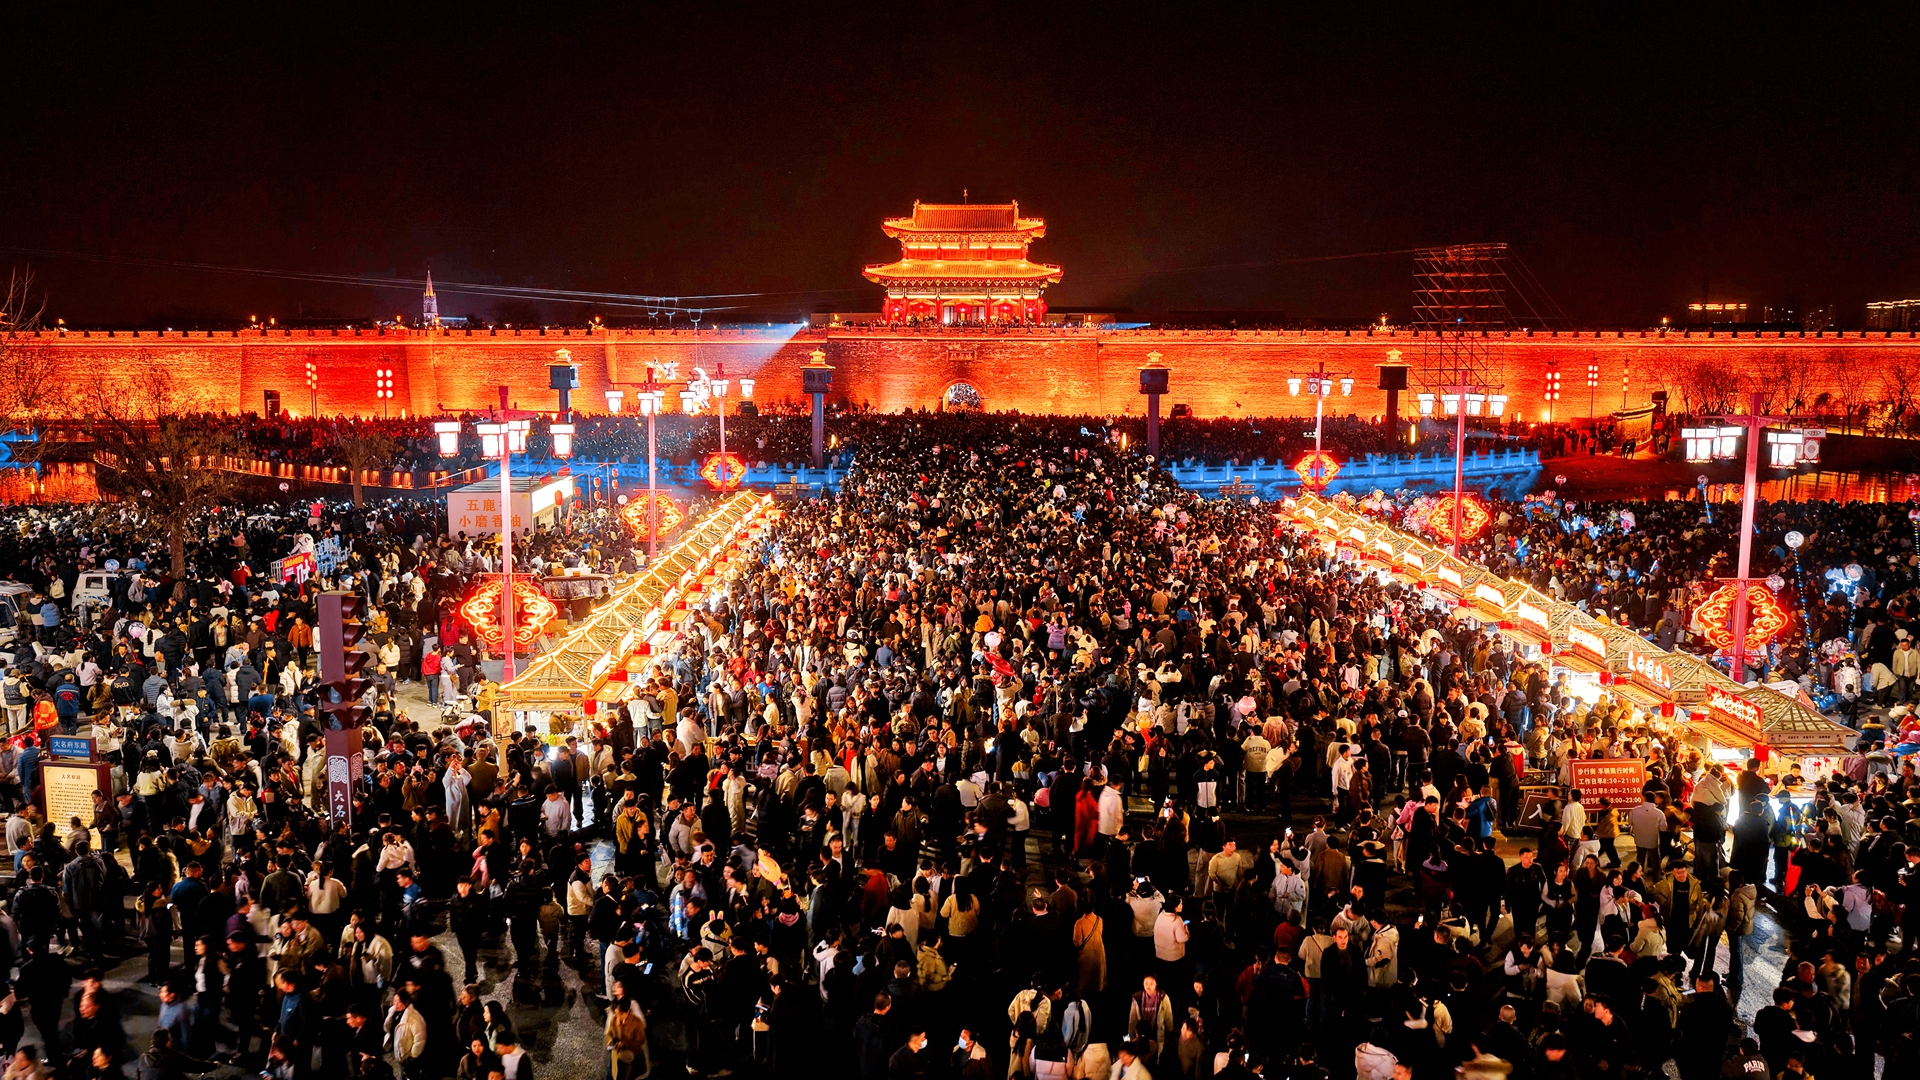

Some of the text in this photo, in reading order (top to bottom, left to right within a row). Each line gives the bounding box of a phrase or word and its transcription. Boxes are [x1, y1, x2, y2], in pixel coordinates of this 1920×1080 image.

[54, 741, 87, 749] 大名府东路
[1578, 768, 1596, 776] 步行街
[1743, 1060, 1765, 1073] PARIS
